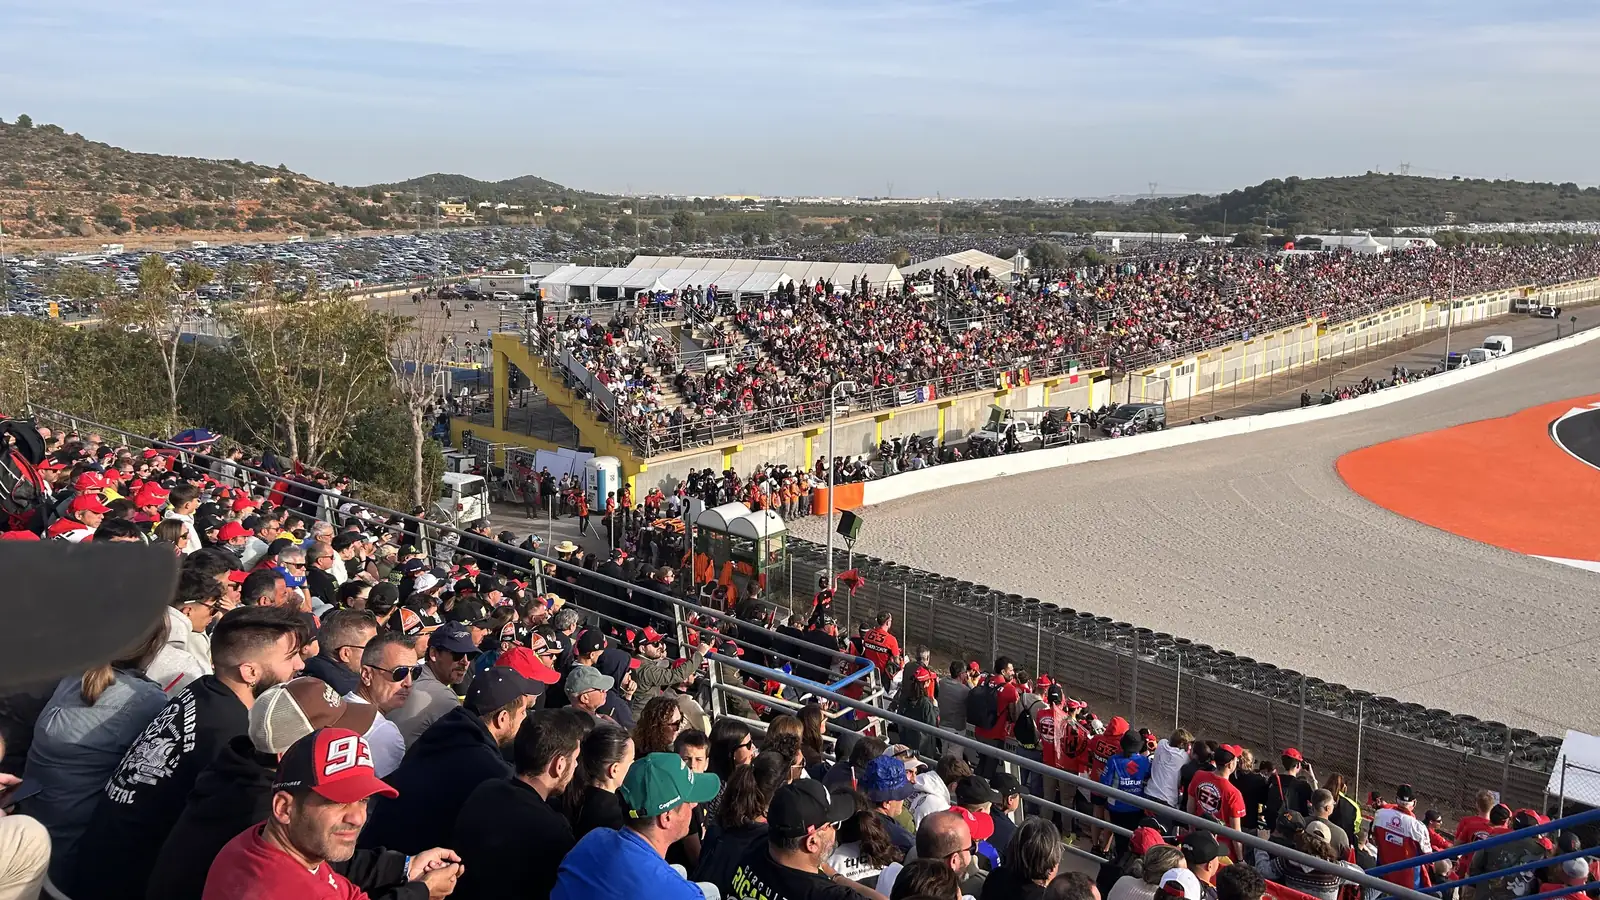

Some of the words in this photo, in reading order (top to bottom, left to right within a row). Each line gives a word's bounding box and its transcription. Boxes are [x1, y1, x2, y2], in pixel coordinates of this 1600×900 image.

[868, 630, 886, 644] 63
[184, 700, 196, 753] MURDER
[325, 735, 375, 776] 93
[1095, 740, 1118, 757] 63
[744, 865, 789, 900] CIRCUI
